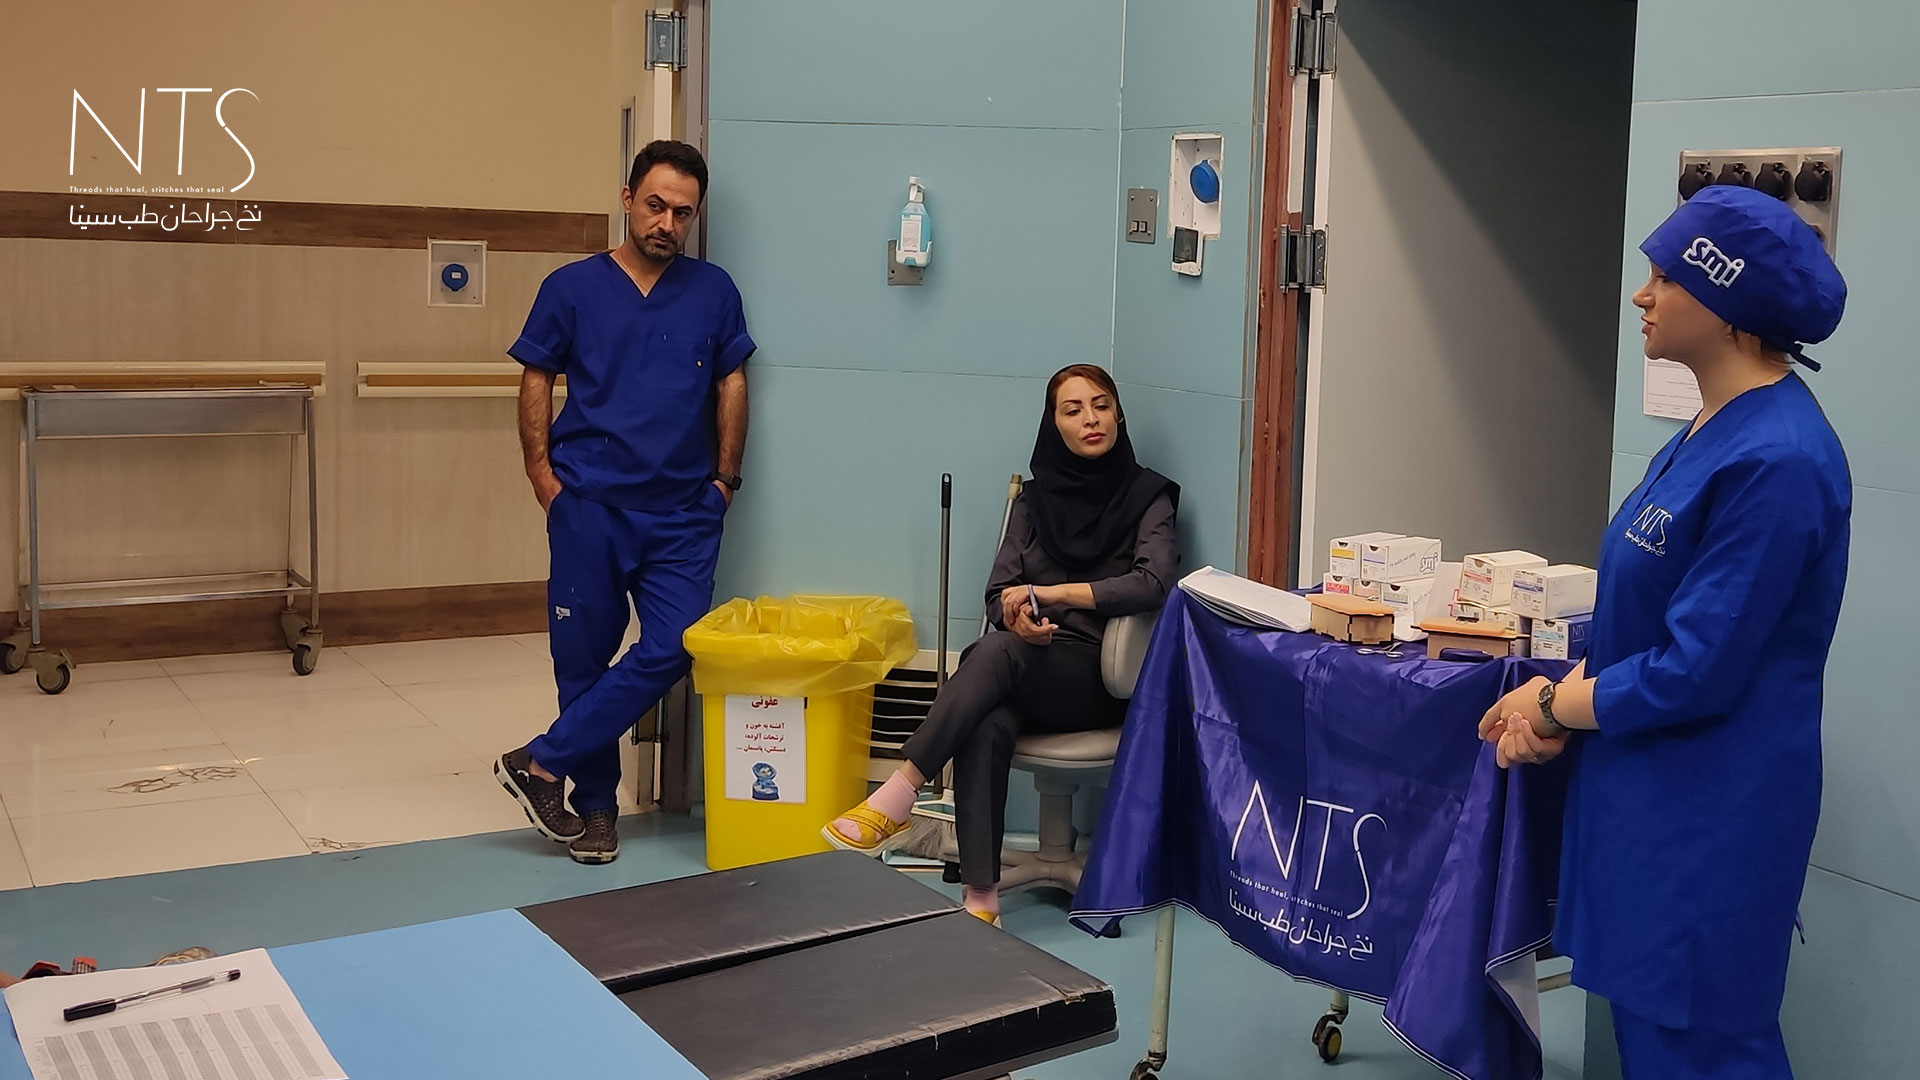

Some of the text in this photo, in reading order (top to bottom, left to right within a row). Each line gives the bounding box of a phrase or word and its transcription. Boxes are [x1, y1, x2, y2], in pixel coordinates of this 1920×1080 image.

[1682, 237, 1745, 288] smi
[1632, 503, 1673, 546] NTS
[1572, 624, 1585, 638] NTS
[1231, 779, 1388, 920] NTS
[1230, 870, 1344, 918] Threads that heal, stches that seal
[1258, 908, 1290, 933] طب
[1288, 916, 1347, 956] جراحان
[1349, 933, 1374, 961] نخ
